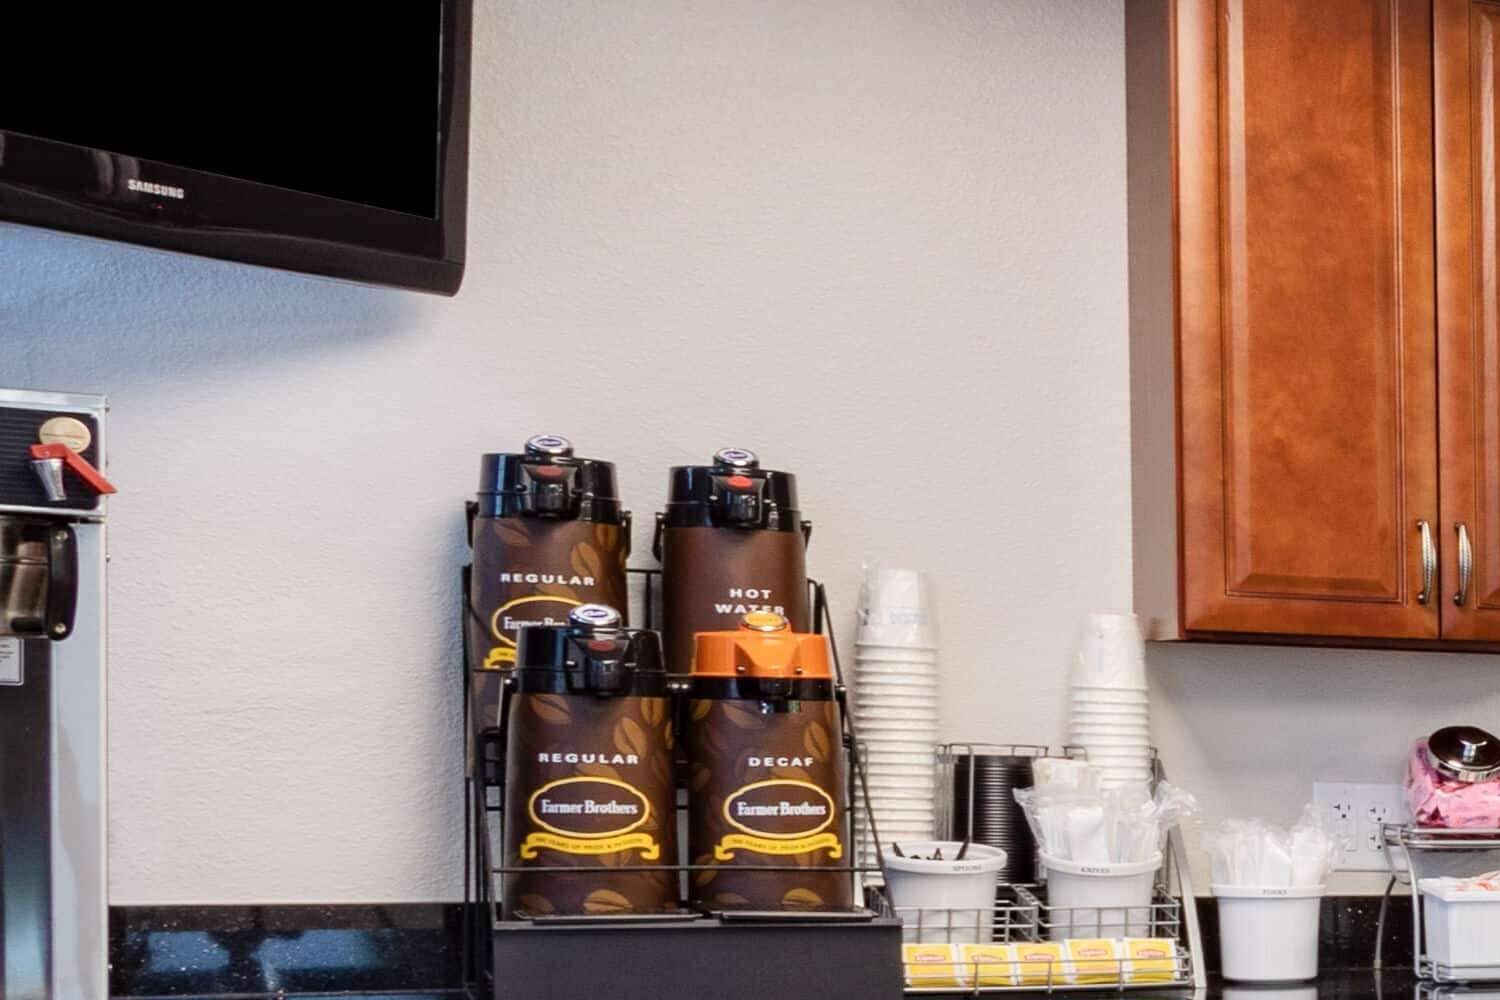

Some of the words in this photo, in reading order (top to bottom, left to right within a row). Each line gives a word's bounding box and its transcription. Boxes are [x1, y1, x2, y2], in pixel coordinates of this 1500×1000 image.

[127, 179, 184, 199] SAMSUNG
[500, 573, 595, 586] REGULAR
[729, 588, 772, 600] HOT
[714, 603, 784, 616] WATER
[538, 752, 639, 765] REGULAR
[747, 756, 814, 768] DECAF
[541, 799, 583, 814] Farmer
[584, 799, 638, 815] Brothers
[736, 801, 778, 816] Farmer
[779, 801, 826, 817] Brothers
